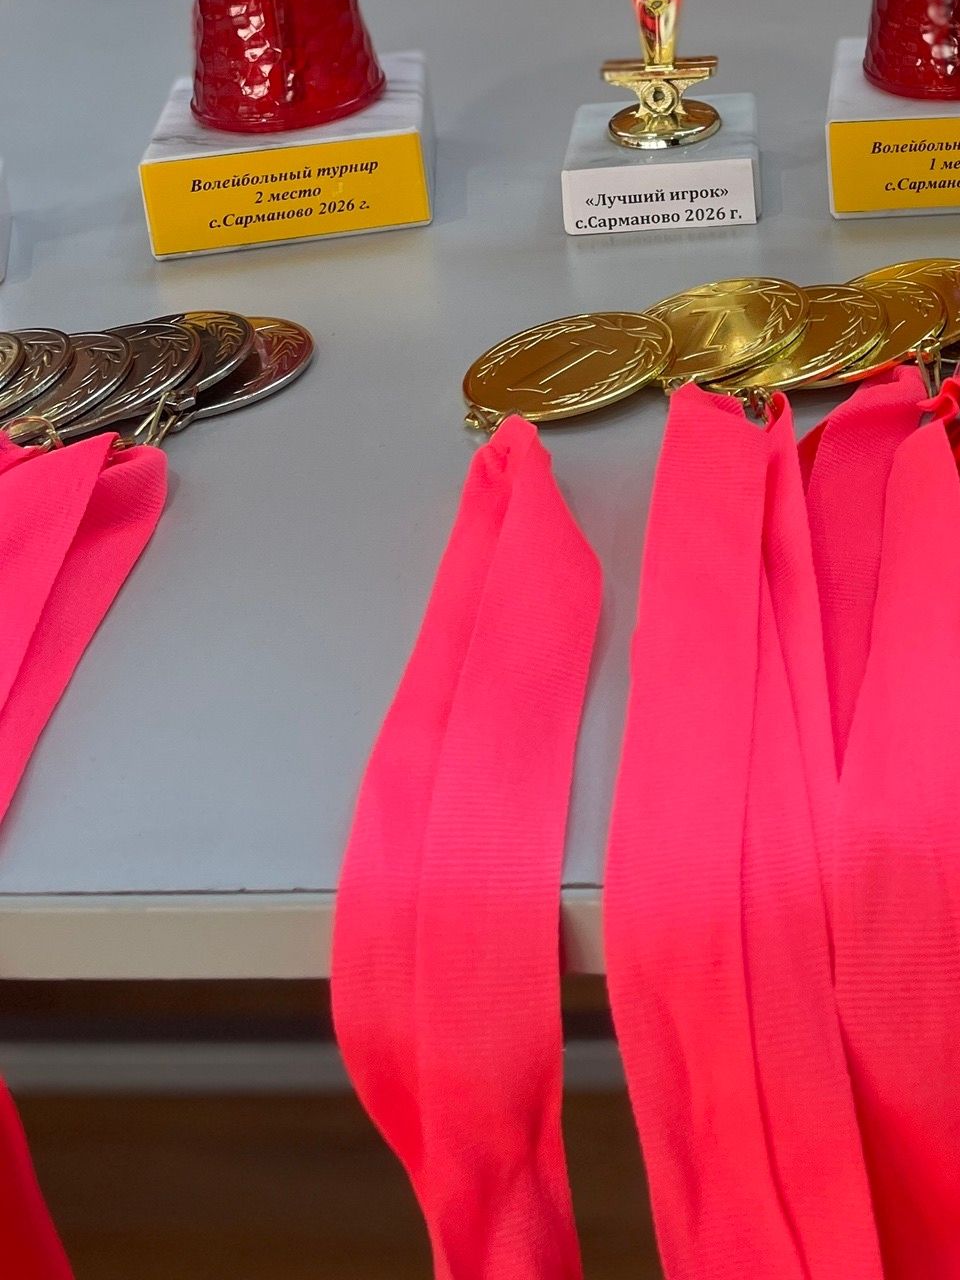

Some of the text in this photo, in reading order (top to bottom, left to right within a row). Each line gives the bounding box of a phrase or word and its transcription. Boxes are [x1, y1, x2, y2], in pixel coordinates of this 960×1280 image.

[928, 157, 936, 171] 1
[190, 160, 379, 193] Волейбольный турнир
[254, 187, 322, 204] 2 место
[585, 187, 729, 209] «Лучший игрок»
[208, 198, 371, 229] с.Сарманово 2026 г.
[575, 207, 742, 231] с.Сарманово 2026 г.
